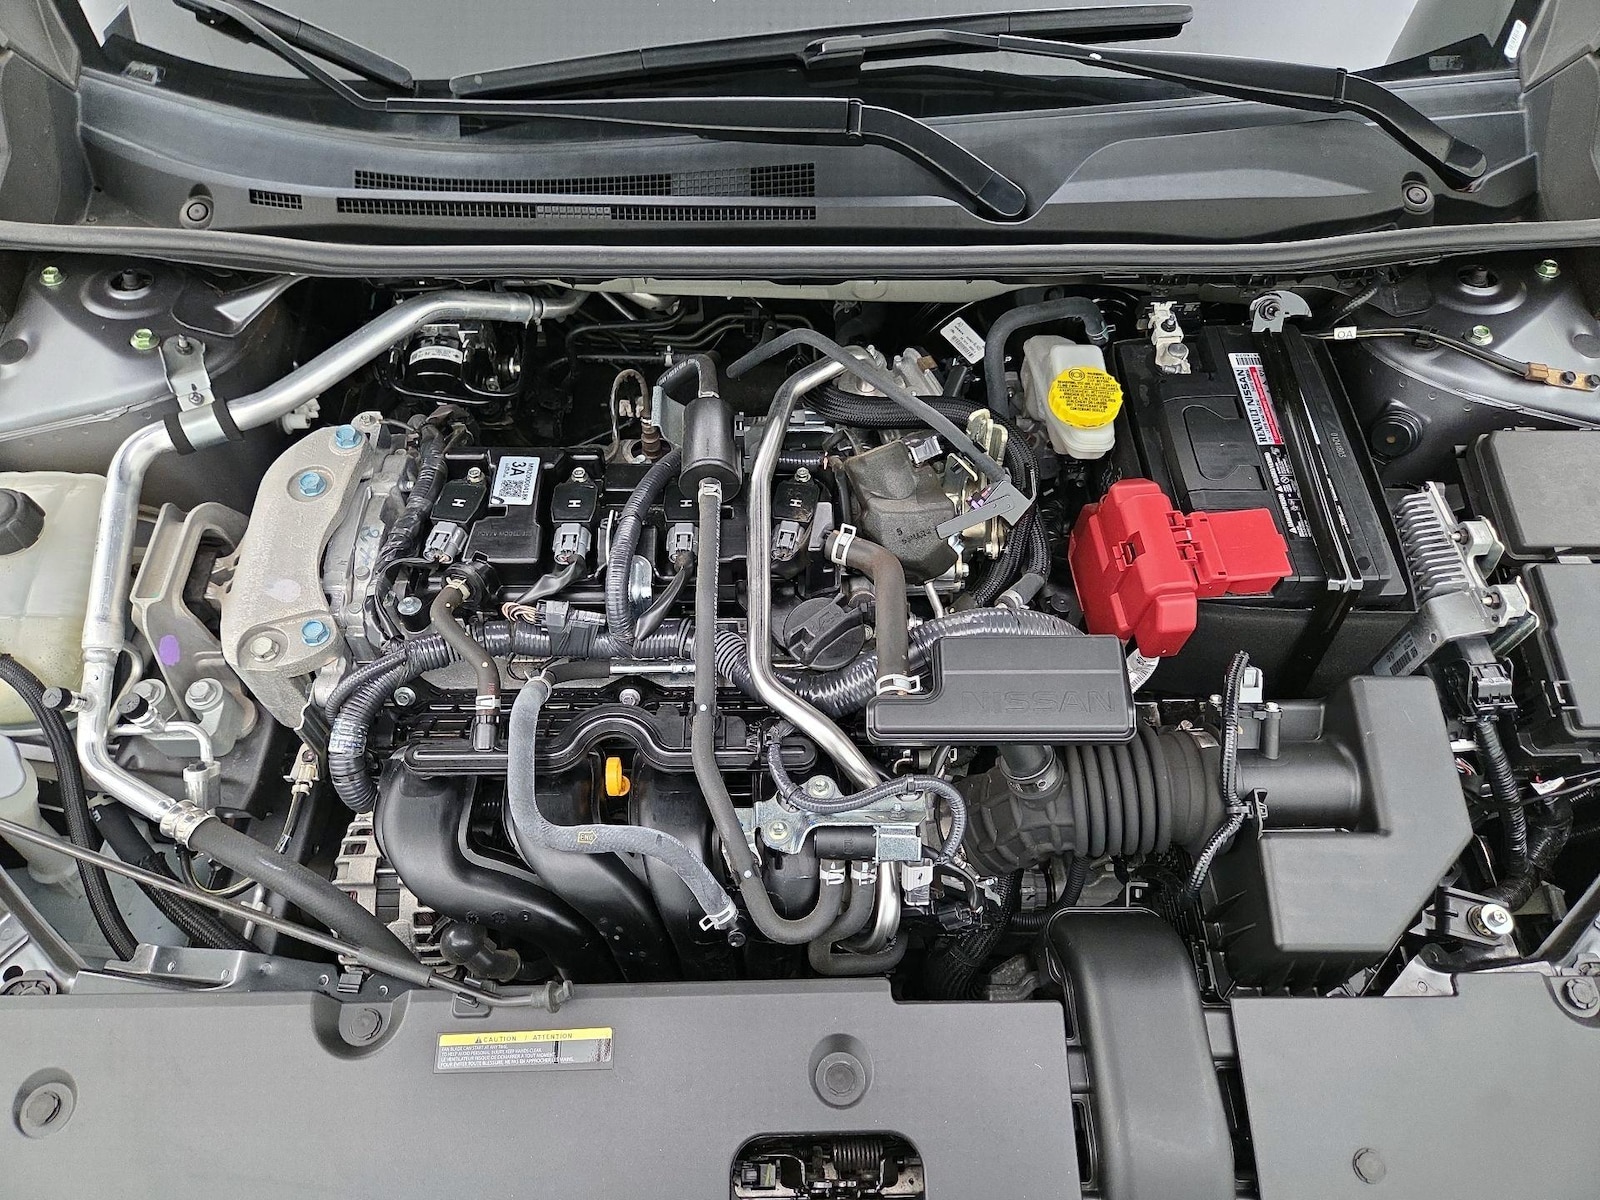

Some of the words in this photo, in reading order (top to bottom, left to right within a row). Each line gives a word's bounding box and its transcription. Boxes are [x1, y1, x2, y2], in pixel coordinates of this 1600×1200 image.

[1236, 369, 1255, 406] NISSAN
[1250, 406, 1268, 443] RENAULT
[510, 462, 526, 476] 3A
[452, 498, 466, 508] H
[568, 500, 582, 508] H
[680, 500, 692, 508] H
[790, 498, 802, 508] H
[961, 690, 1115, 713] NISSAN
